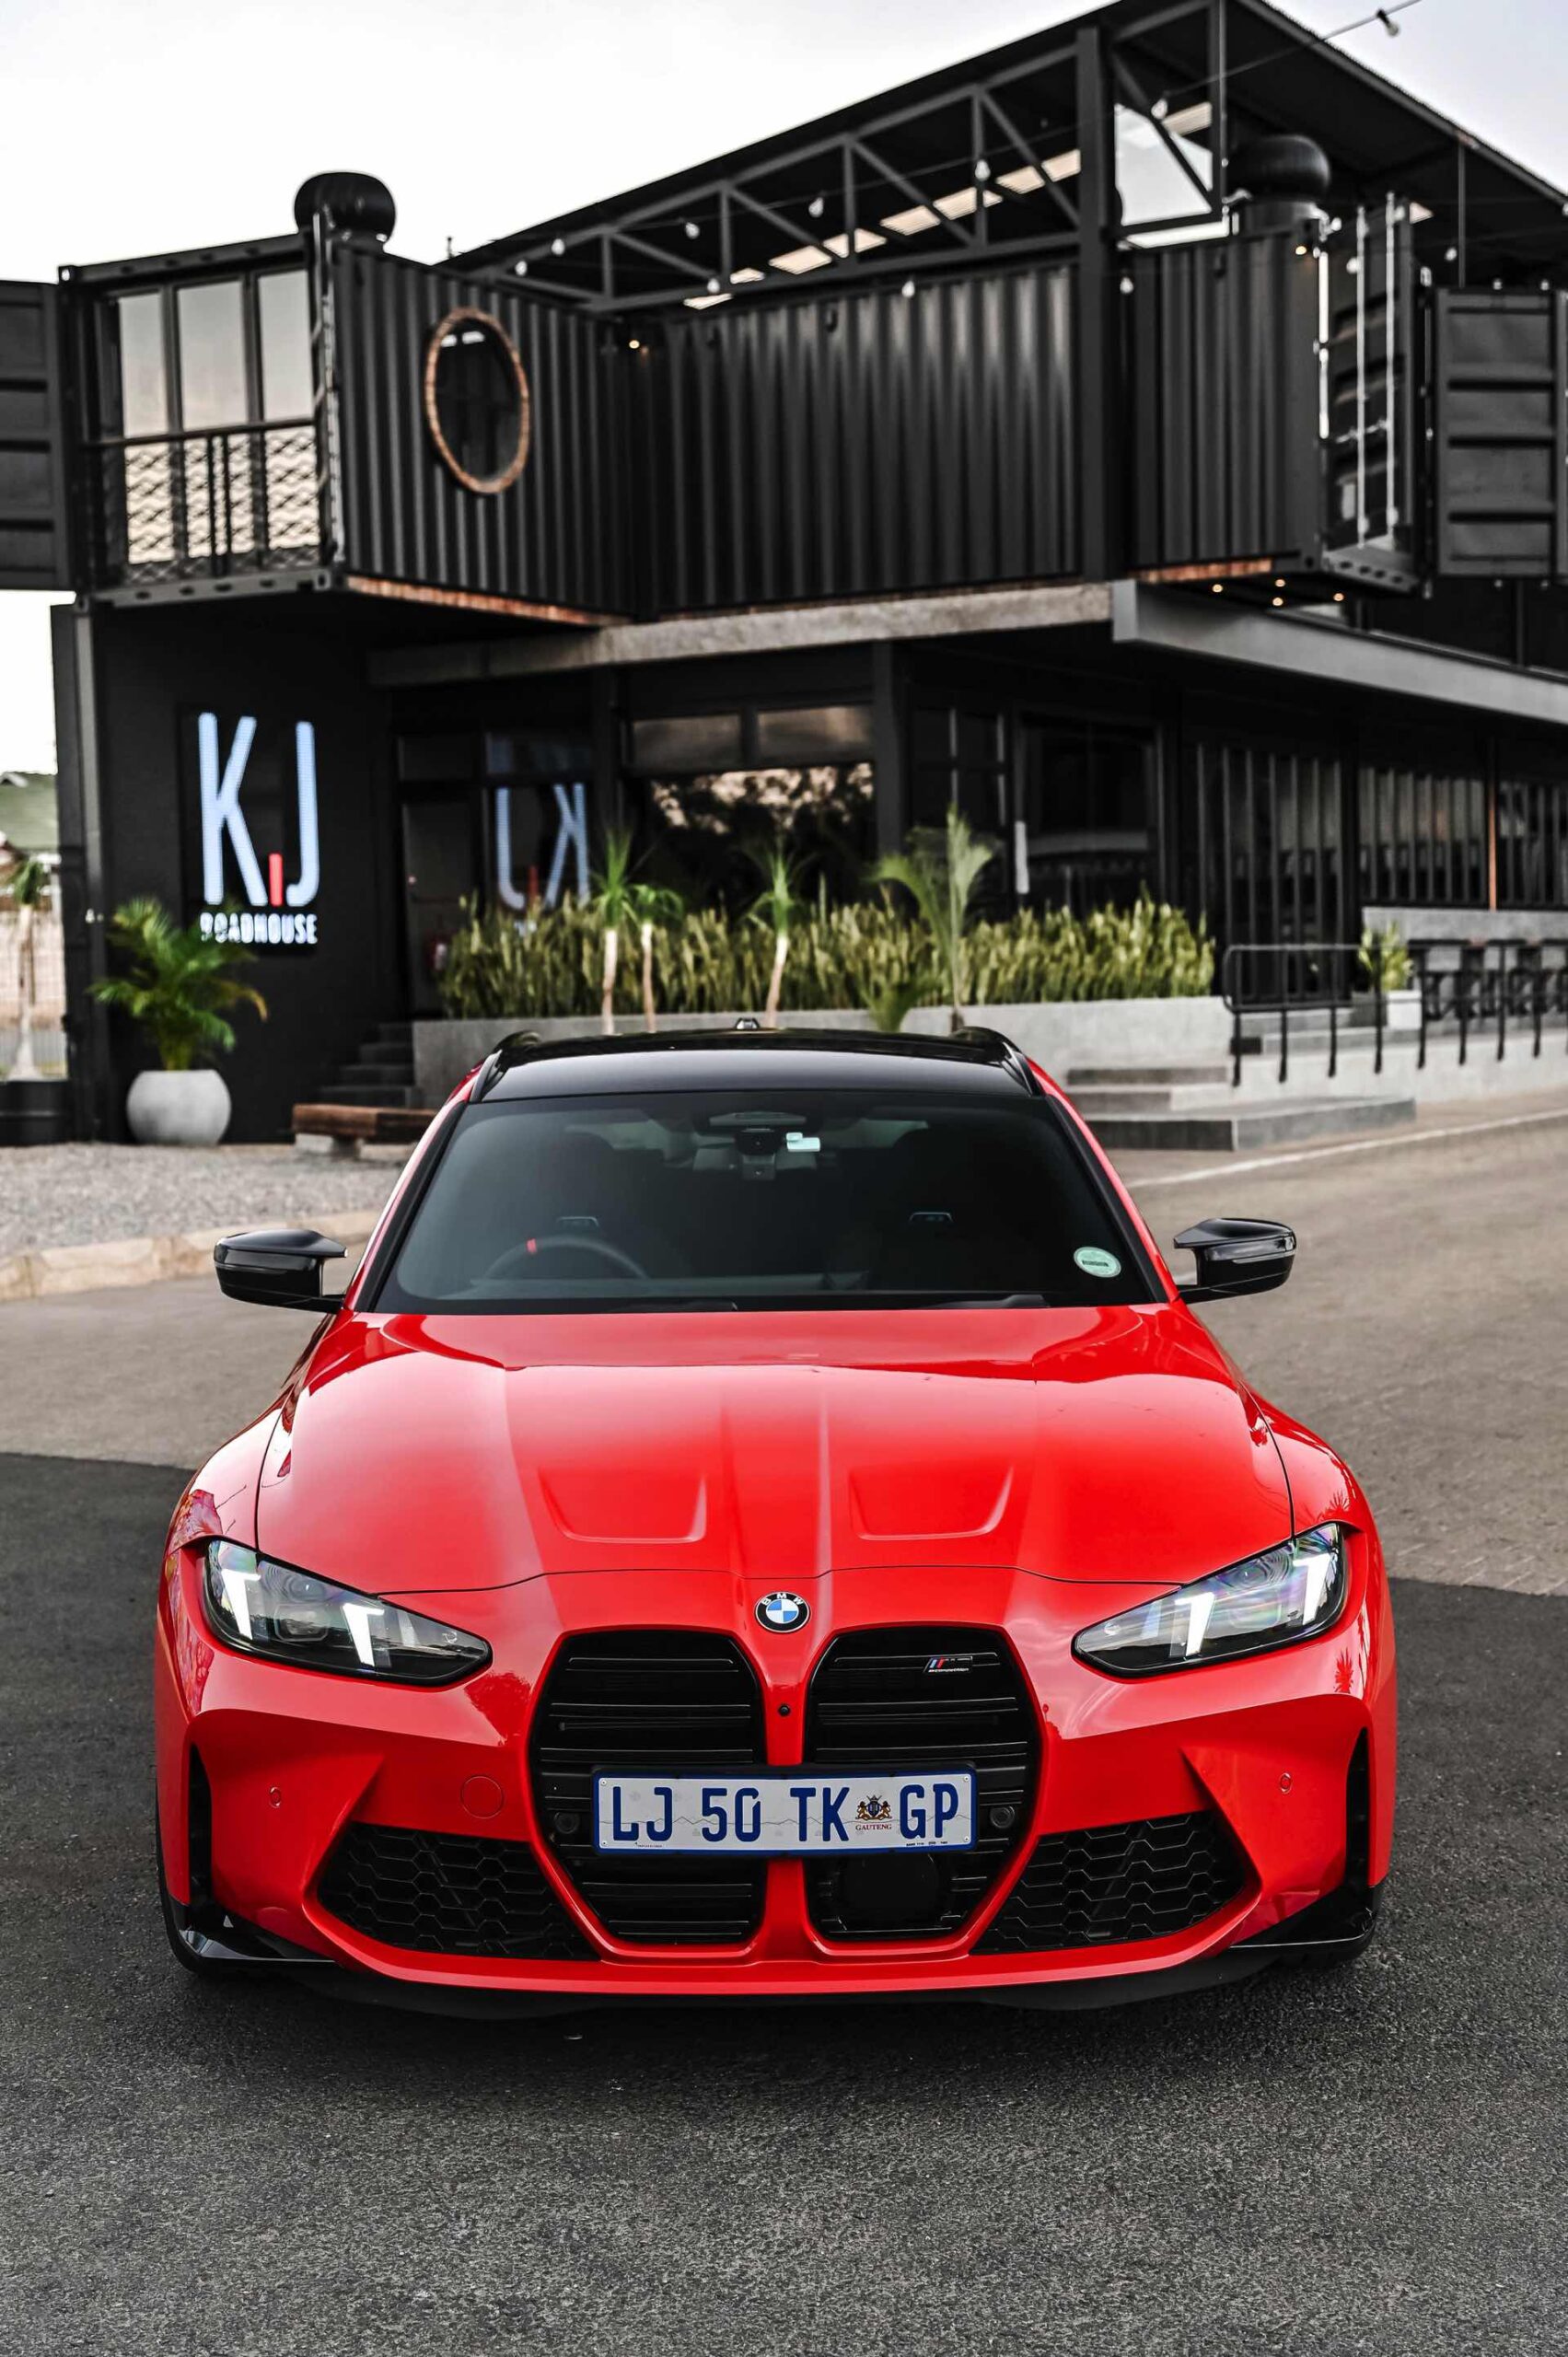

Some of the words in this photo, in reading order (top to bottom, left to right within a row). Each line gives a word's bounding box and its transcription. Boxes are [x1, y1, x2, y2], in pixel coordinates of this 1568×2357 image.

[200, 912, 318, 943] ROADHOUSE
[761, 1593, 804, 1606] BMW
[612, 1786, 672, 1841] LJ
[702, 1787, 761, 1842] 50
[790, 1787, 850, 1841] TK
[900, 1783, 958, 1839] GP
